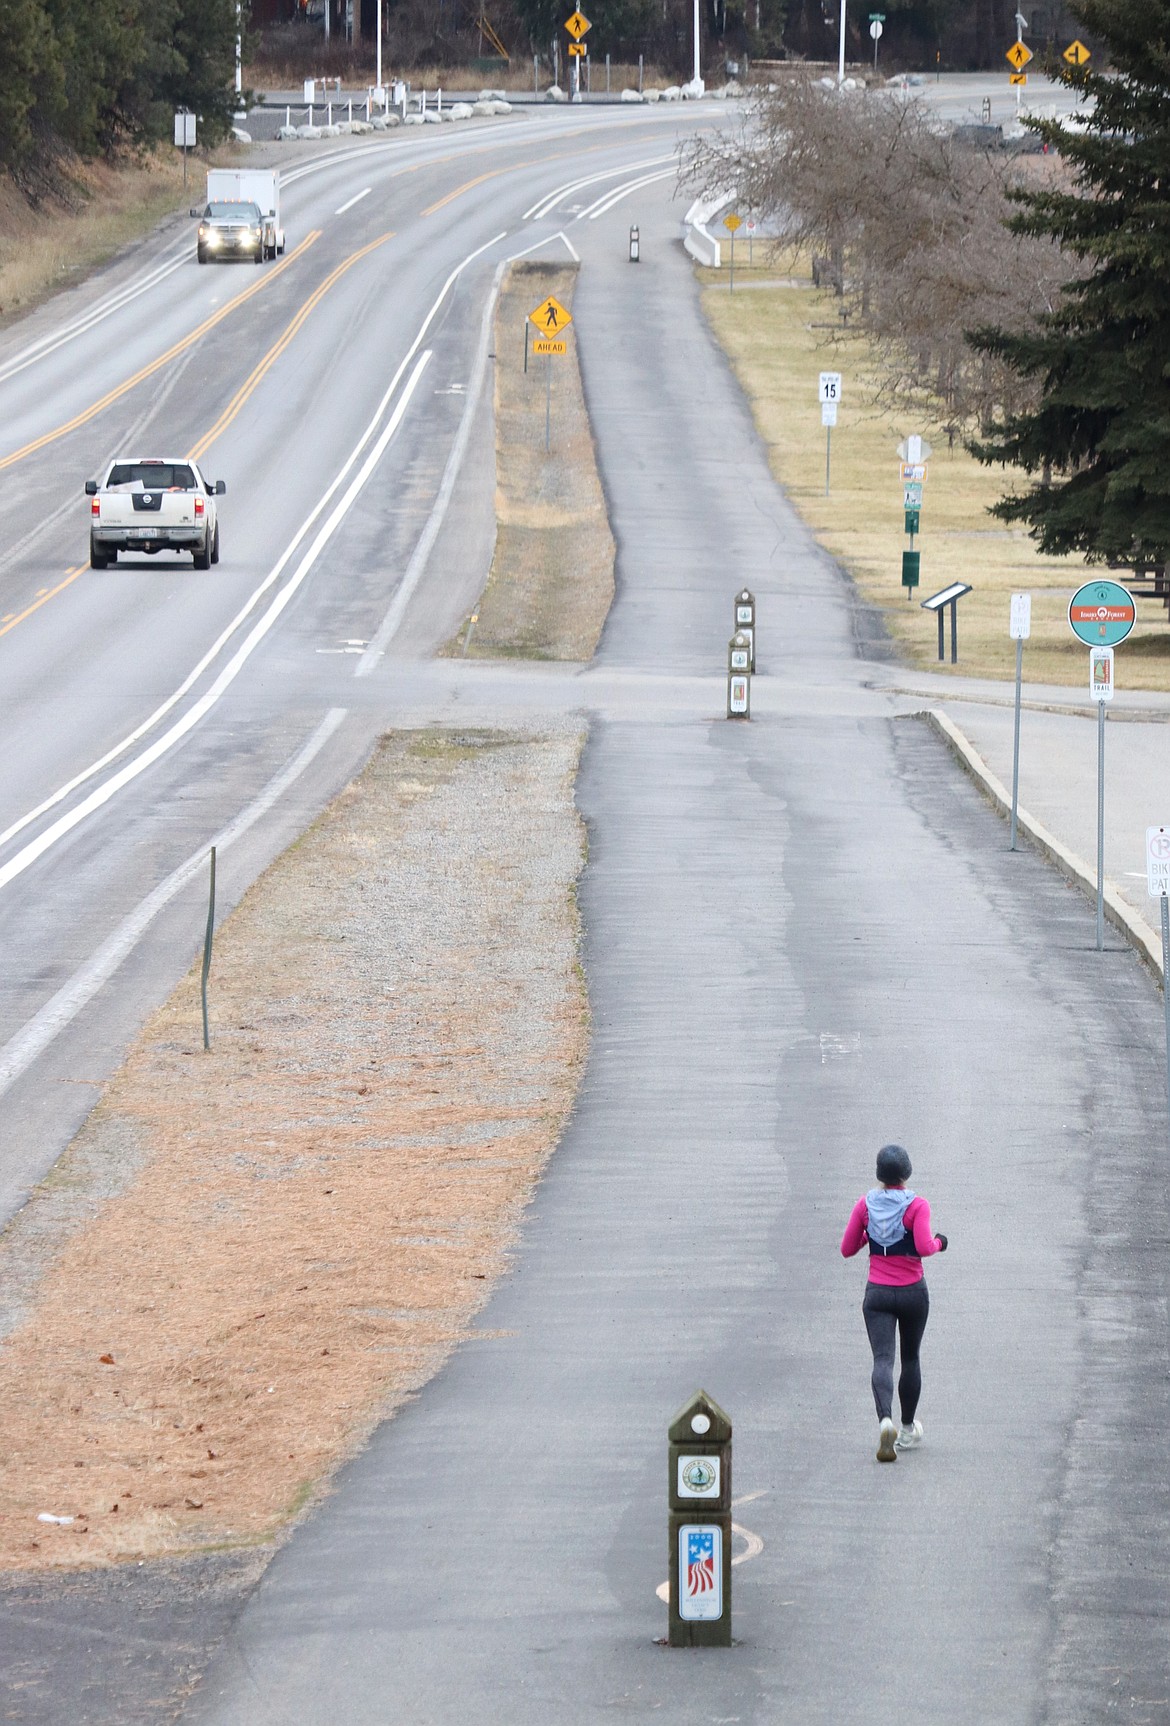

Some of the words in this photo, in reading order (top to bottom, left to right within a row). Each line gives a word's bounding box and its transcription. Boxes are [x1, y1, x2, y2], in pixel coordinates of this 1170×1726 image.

[538, 343, 562, 351] AHEAD
[824, 383, 836, 398] 15
[1151, 863, 1170, 875] BIK
[1151, 877, 1170, 890] PAT
